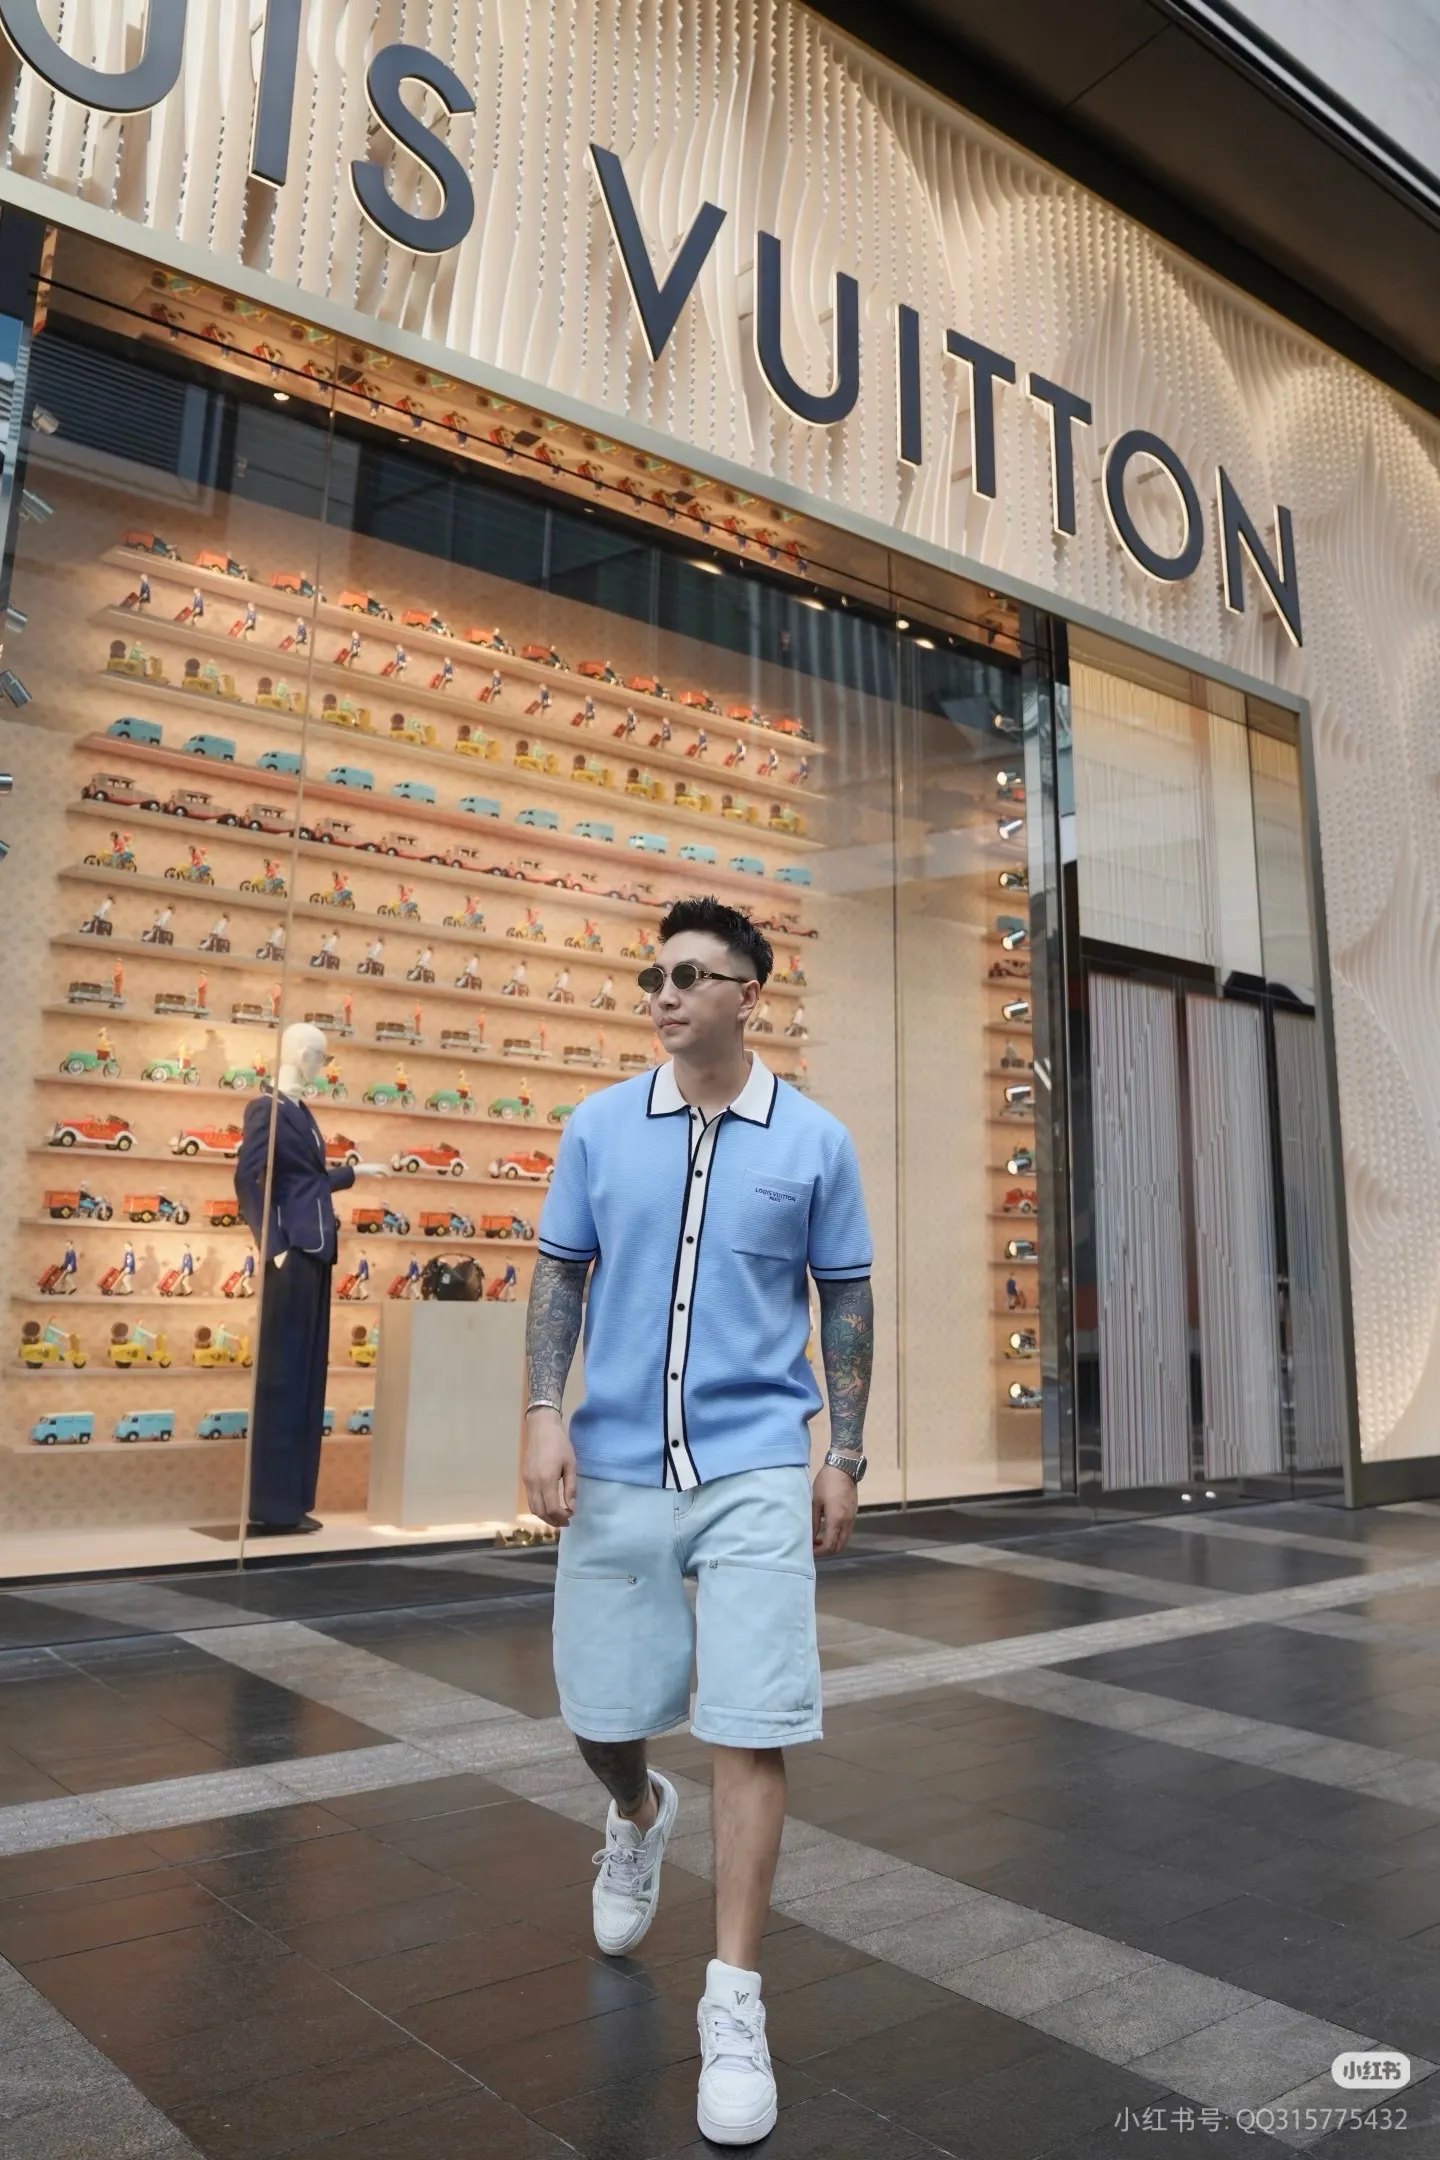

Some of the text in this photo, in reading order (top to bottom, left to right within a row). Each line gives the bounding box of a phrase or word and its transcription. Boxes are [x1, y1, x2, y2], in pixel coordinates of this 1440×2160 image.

[587, 143, 1303, 648] VUITTON
[754, 1187, 797, 1202] LOUIS VUITTON
